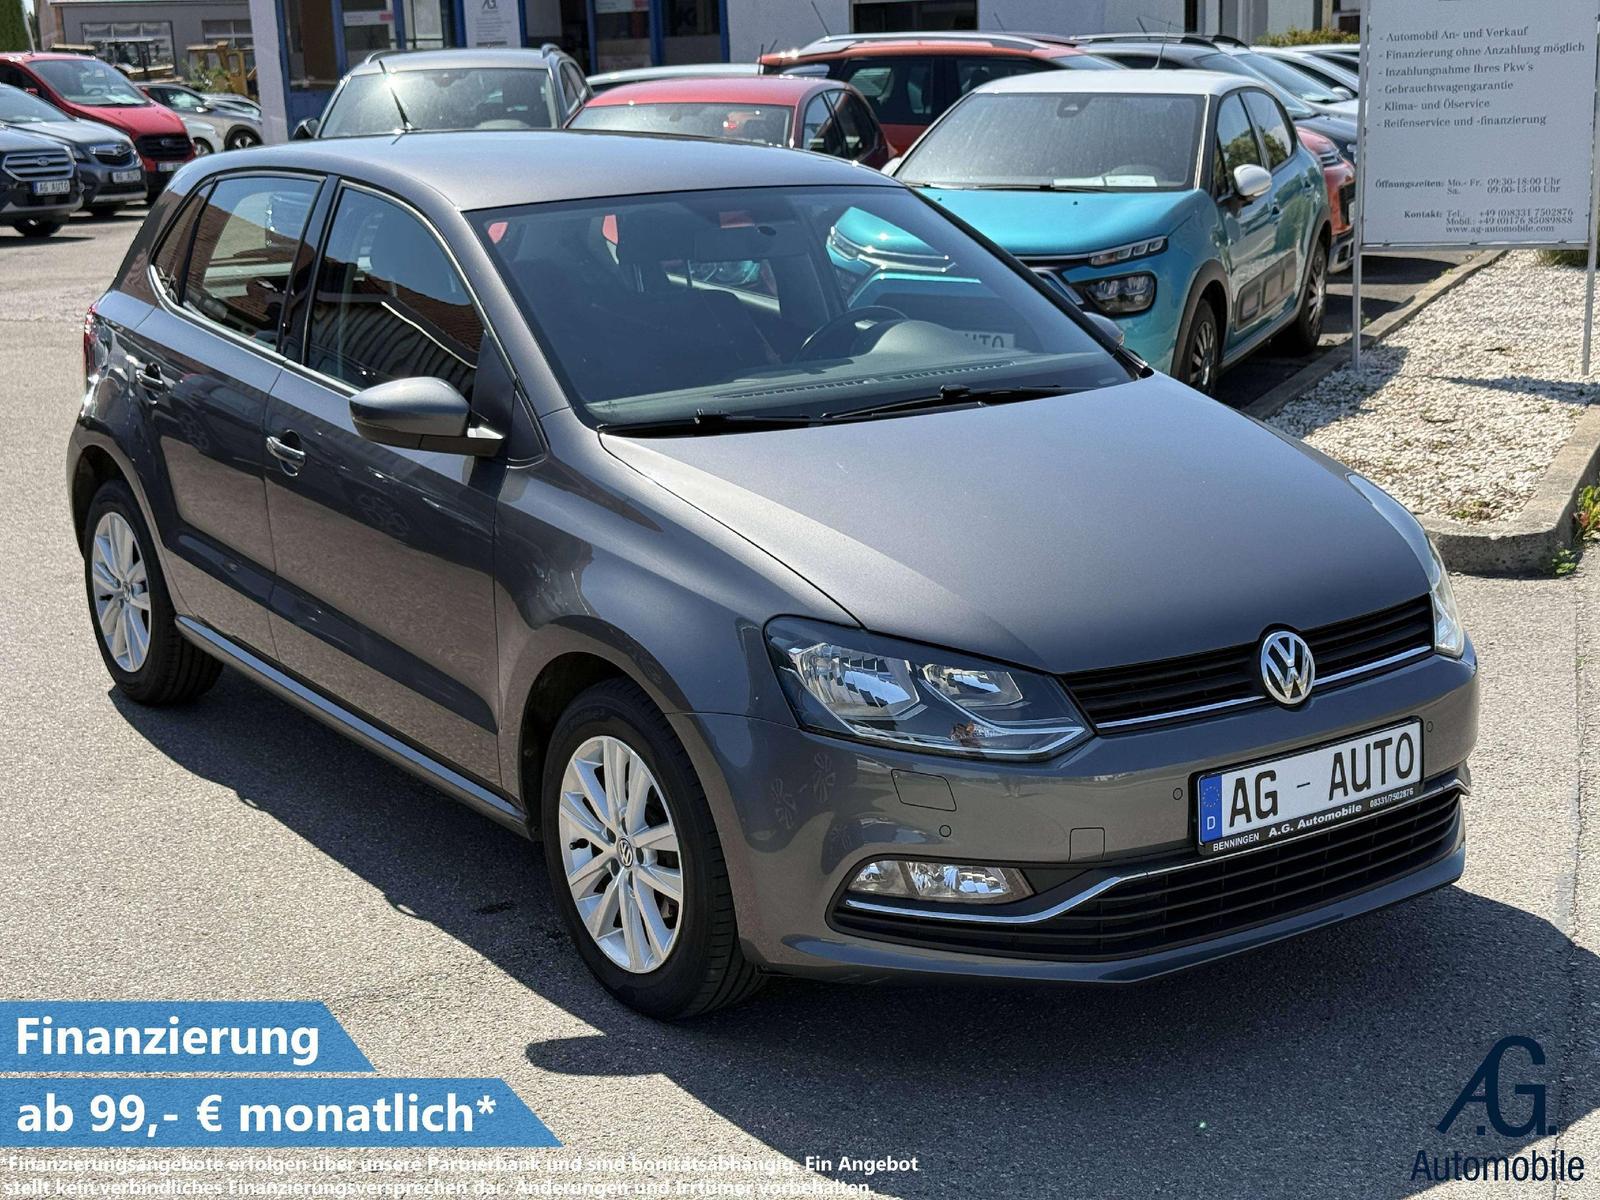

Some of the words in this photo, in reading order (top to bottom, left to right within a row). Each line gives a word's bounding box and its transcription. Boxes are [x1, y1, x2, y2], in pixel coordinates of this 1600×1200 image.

[1386, 30, 1438, 42] Automobil
[1441, 30, 1459, 40] An-
[1463, 28, 1483, 39] und
[1486, 26, 1529, 38] Verkauf
[1386, 47, 1454, 60] Finanzierung
[1455, 46, 1481, 57] ohne
[1484, 44, 1541, 56] Anzahlung
[1543, 42, 1585, 54] möglich
[1385, 65, 1470, 77] Inzahlungnahme
[1473, 63, 1500, 73] Ihres
[1384, 80, 1514, 94] Gebrauchtwagengarantie
[1384, 101, 1418, 112] Klima-
[1421, 100, 1440, 110] und
[1443, 98, 1490, 109] Ölservice
[1384, 117, 1450, 129] Reifenservice
[1454, 116, 1473, 127] und
[1477, 115, 1547, 127] -finanzierung
[1375, 178, 1444, 190] Öffnungszeiten:
[1543, 177, 1561, 185] Uhr
[1543, 185, 1560, 193] Uhr
[1404, 210, 1442, 219] Kontakt:
[1229, 770, 1279, 827] AG
[1329, 732, 1415, 801] AUTO
[1206, 816, 1216, 830] D
[1213, 833, 1260, 851] BENNINGEN
[1268, 824, 1294, 838] A.G.
[1297, 803, 1362, 830] Automobile
[1369, 787, 1414, 808] 08331/7502876
